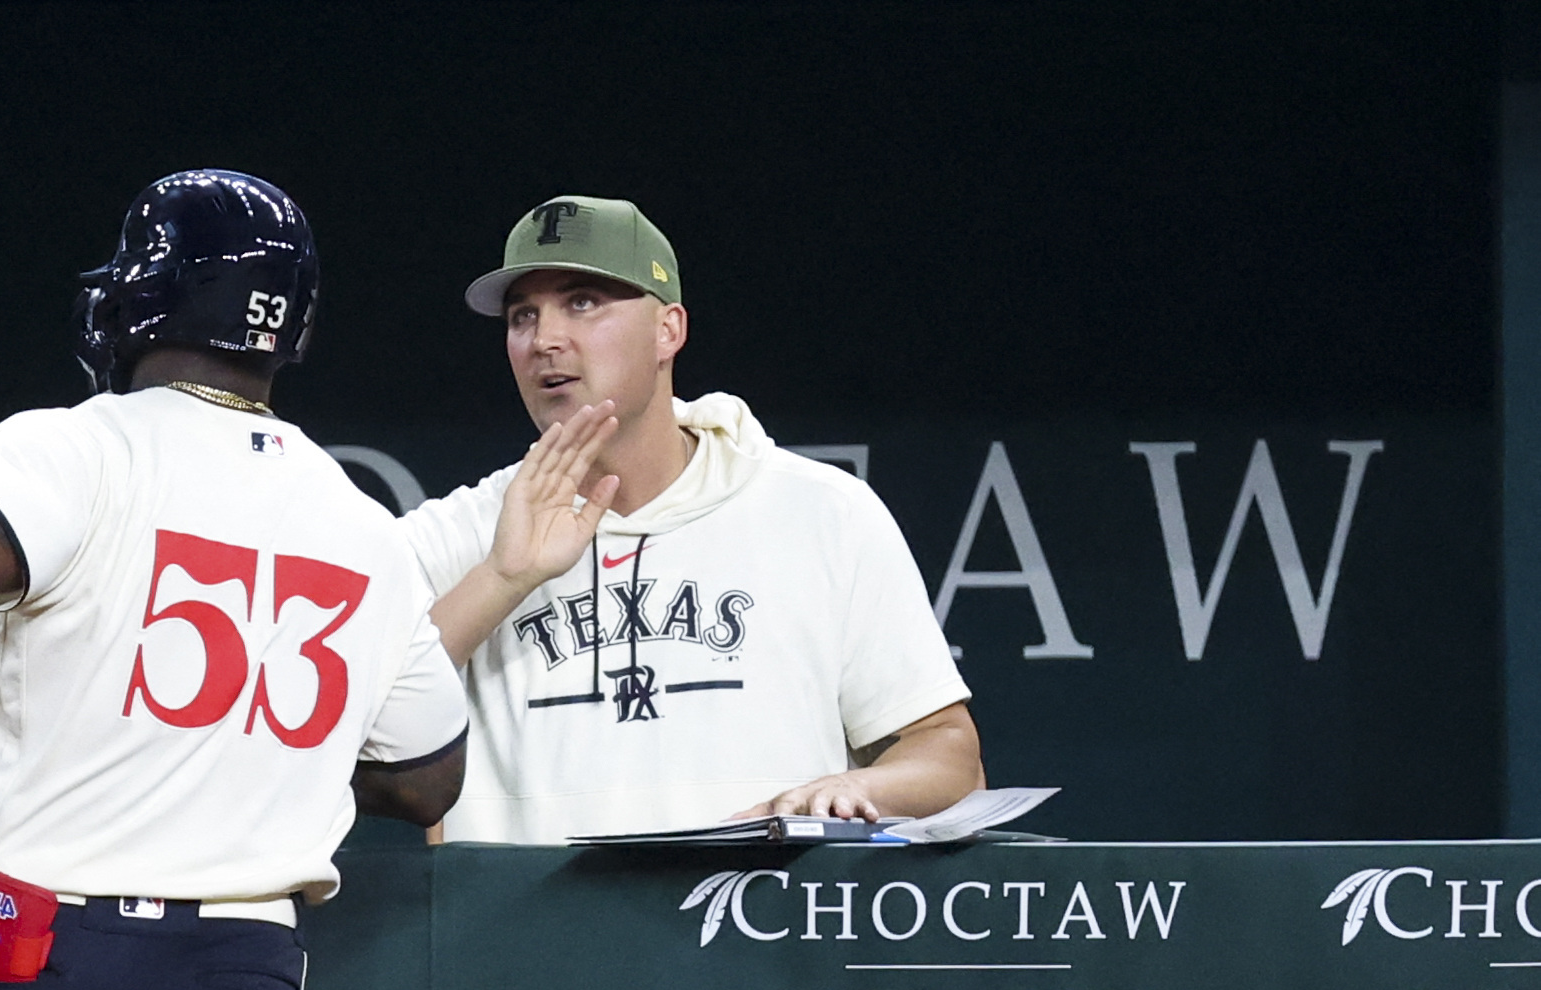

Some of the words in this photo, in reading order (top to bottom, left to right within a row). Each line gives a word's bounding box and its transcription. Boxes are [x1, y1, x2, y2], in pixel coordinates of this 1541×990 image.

[532, 201, 579, 246] T
[246, 290, 288, 329] 53
[121, 528, 371, 749] 53
[513, 578, 755, 672] TEXAS
[731, 868, 1187, 942] CHOCTAW
